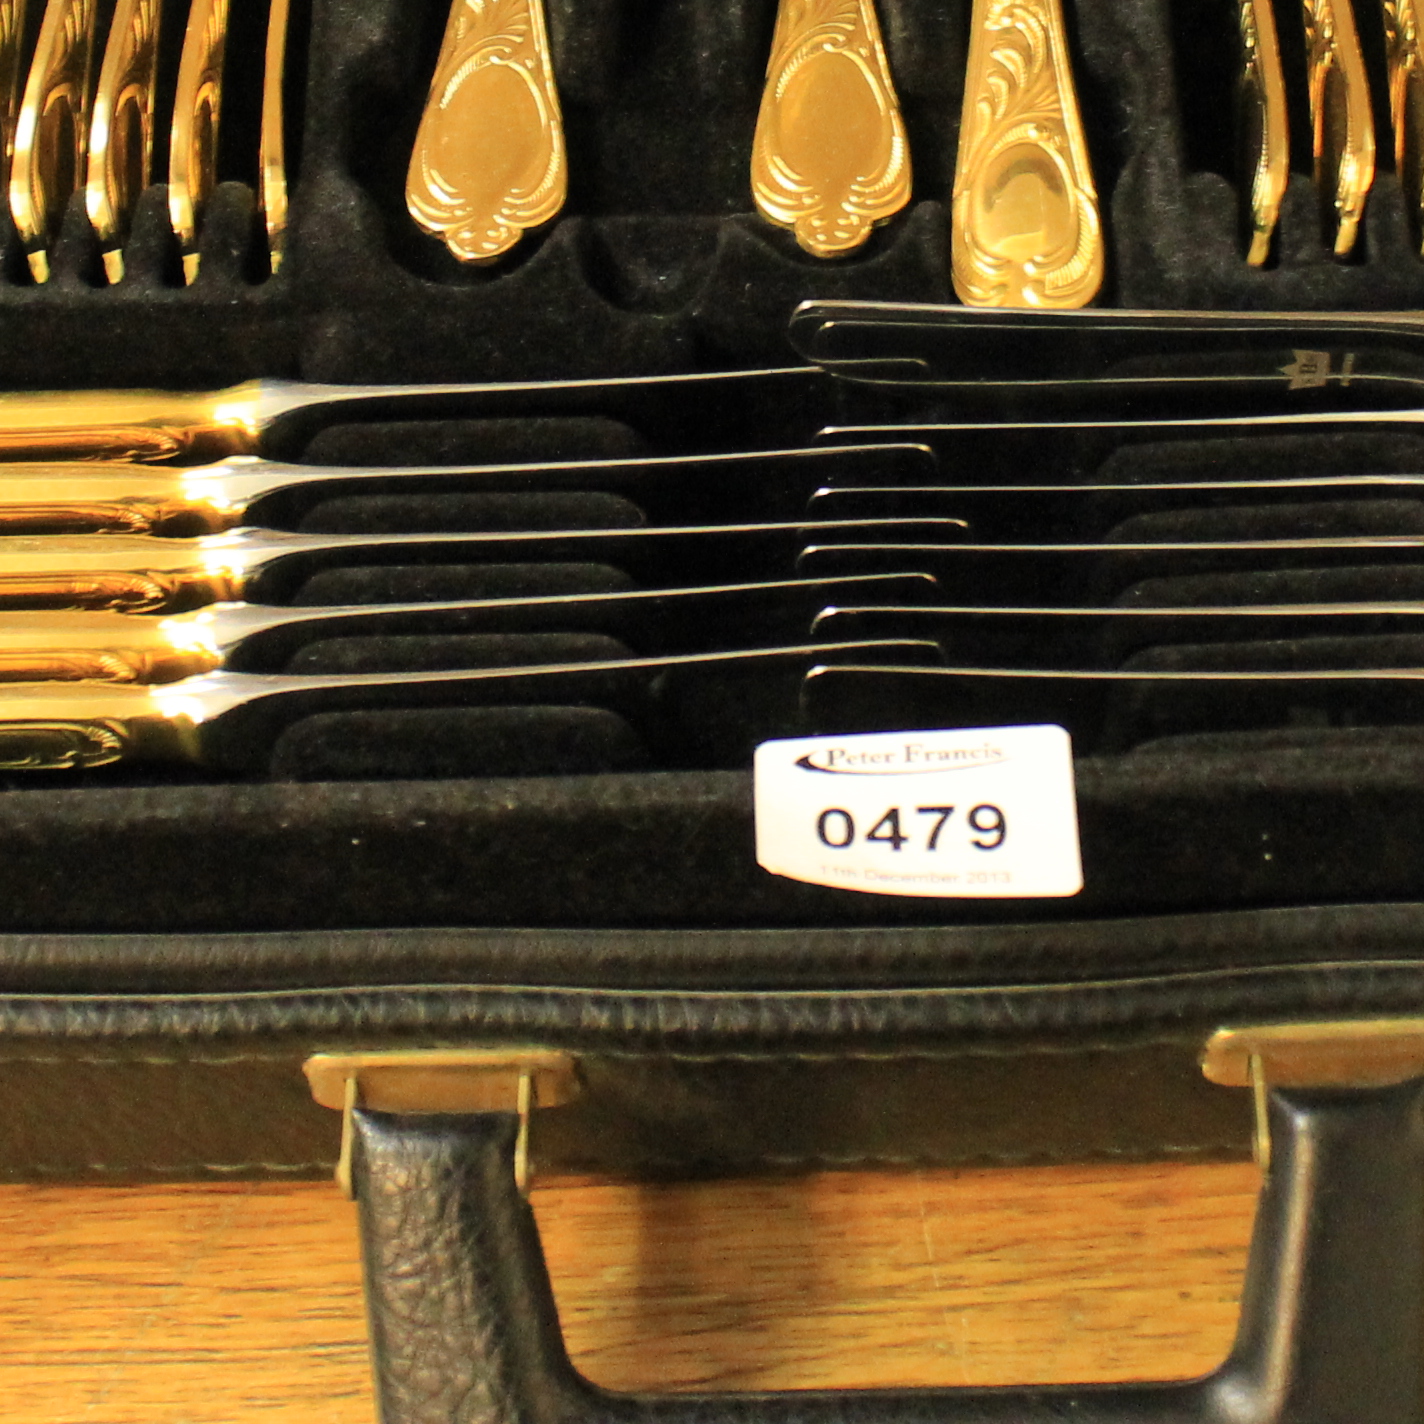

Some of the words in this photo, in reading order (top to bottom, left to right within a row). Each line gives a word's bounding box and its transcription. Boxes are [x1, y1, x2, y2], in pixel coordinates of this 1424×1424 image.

[825, 746, 895, 767] Peter
[904, 742, 1003, 764] Francis
[815, 802, 1008, 852] 0479
[864, 867, 960, 884] December
